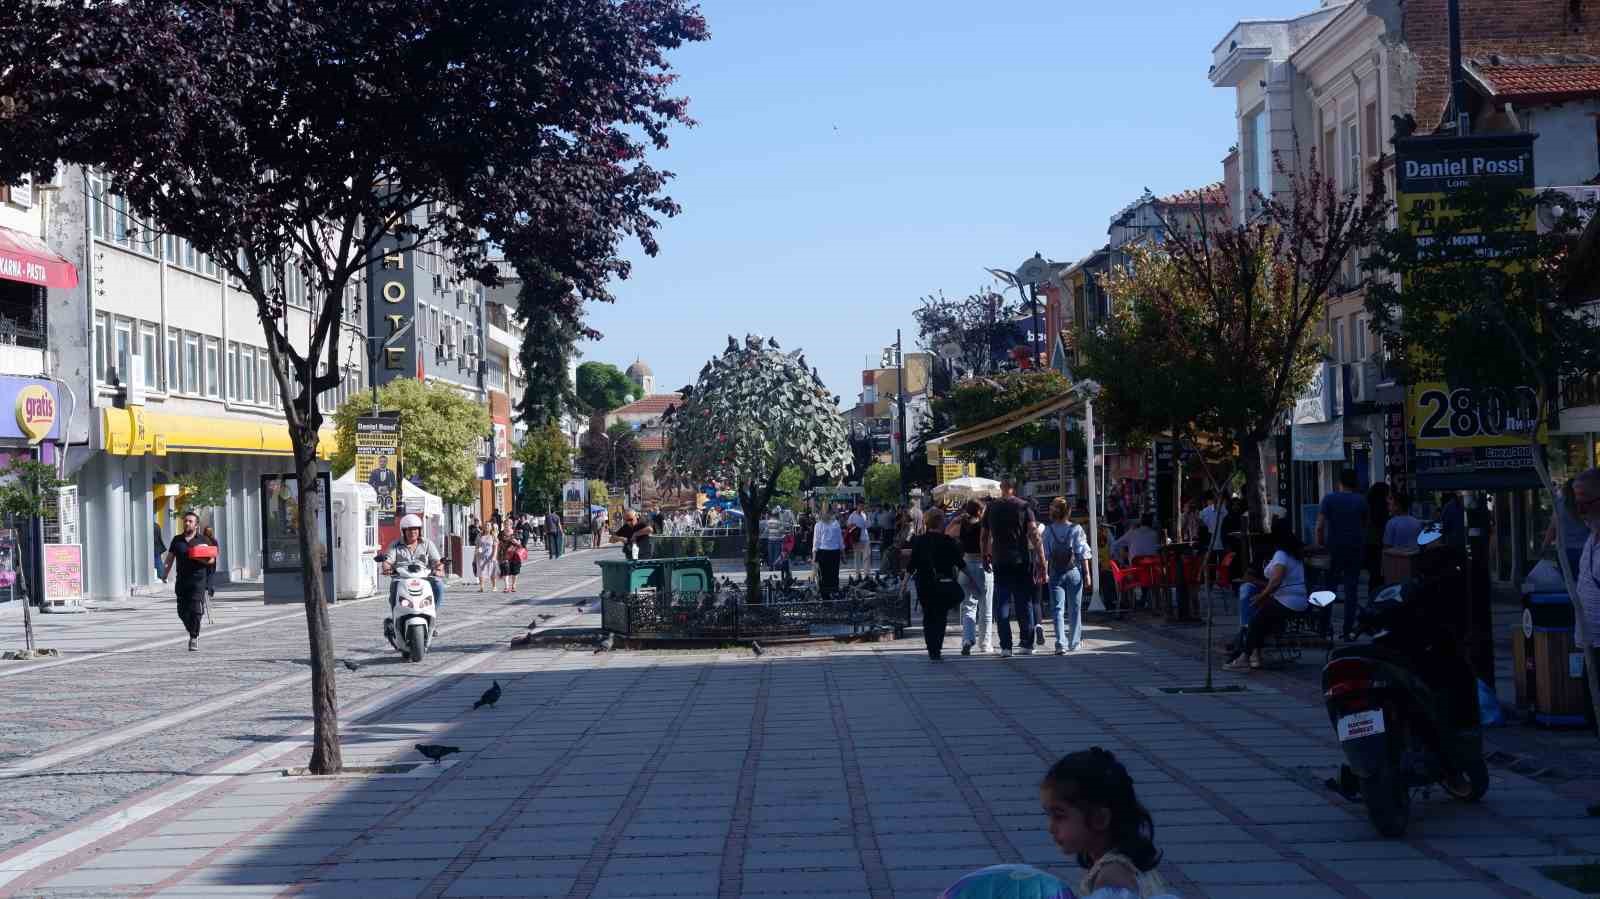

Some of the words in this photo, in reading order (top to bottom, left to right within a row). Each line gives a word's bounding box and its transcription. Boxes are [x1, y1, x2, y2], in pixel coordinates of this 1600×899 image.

[1405, 157, 1467, 177] Daniel
[27, 262, 46, 281] PASTA
[383, 247, 406, 370] HOTE
[26, 391, 53, 423] gratis
